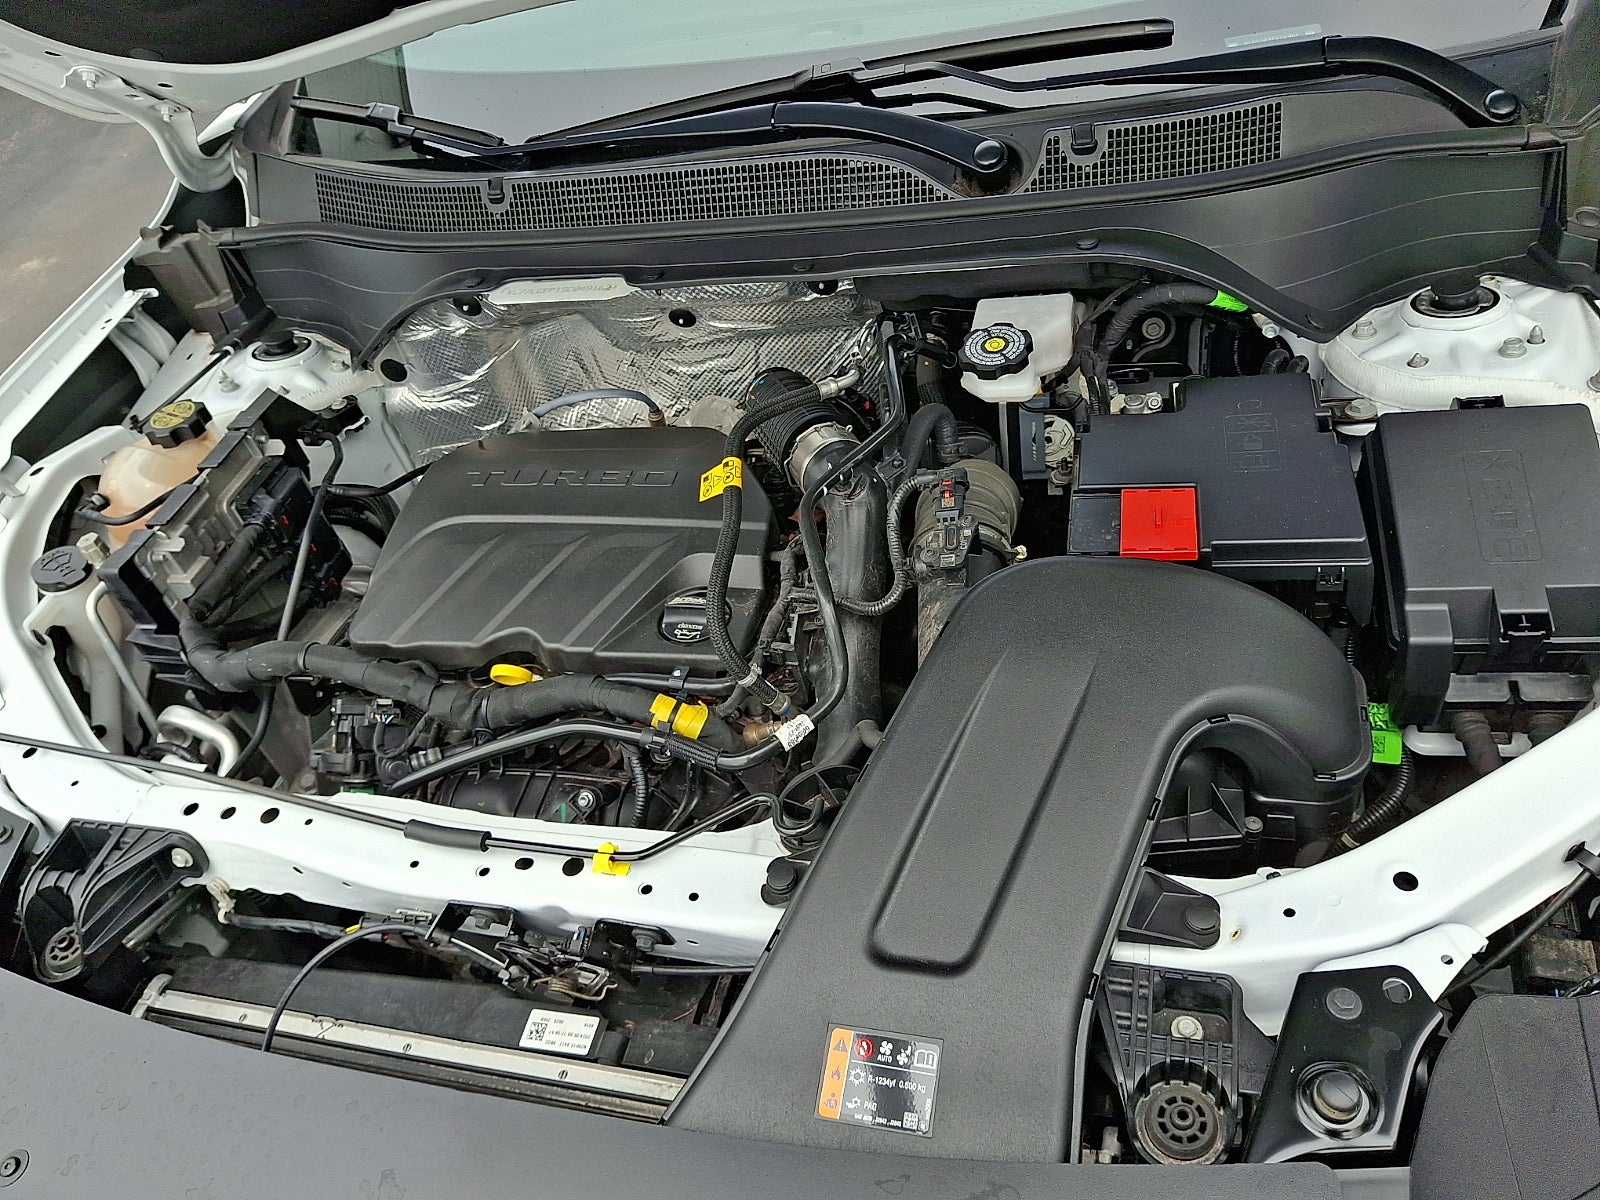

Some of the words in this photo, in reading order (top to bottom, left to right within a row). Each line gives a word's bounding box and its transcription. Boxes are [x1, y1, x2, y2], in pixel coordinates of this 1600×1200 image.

[467, 469, 678, 487] TURBO
[876, 1055, 893, 1063] AUTO
[918, 1083, 926, 1094] kg
